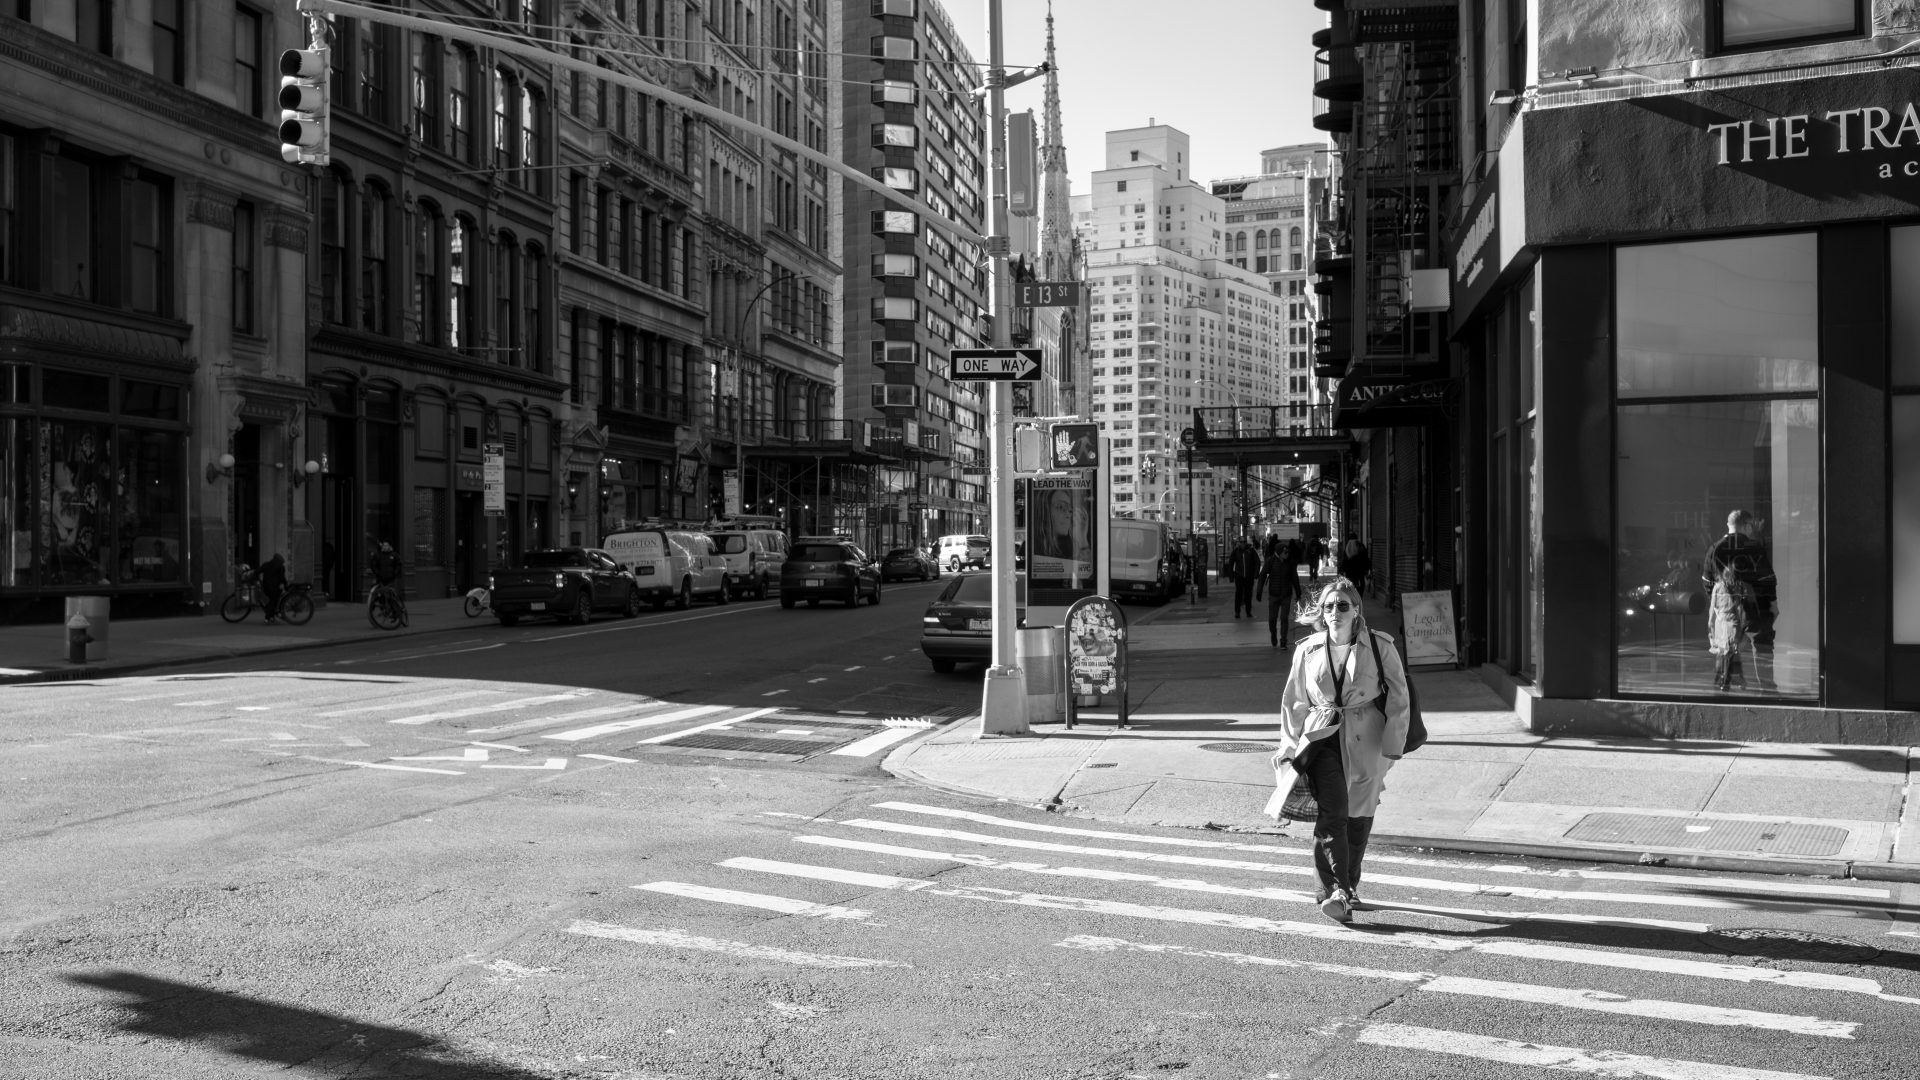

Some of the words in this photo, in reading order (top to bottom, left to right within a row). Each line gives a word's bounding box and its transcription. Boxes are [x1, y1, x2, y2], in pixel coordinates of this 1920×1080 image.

[1707, 114, 1809, 165] THE
[1825, 102, 1920, 153] TRA
[1879, 163, 1893, 178] a
[1023, 286, 1031, 304] E
[1038, 285, 1052, 304] 13
[1058, 285, 1068, 297] St
[963, 359, 989, 372] ONE
[1001, 359, 1028, 372] WAY
[1033, 479, 1055, 488] LEAD
[1056, 479, 1072, 488] THE
[1072, 479, 1091, 488] WAY
[610, 539, 657, 549] BRIGHTON
[1414, 612, 1442, 626] Legal
[1406, 625, 1453, 638] Cannabis
